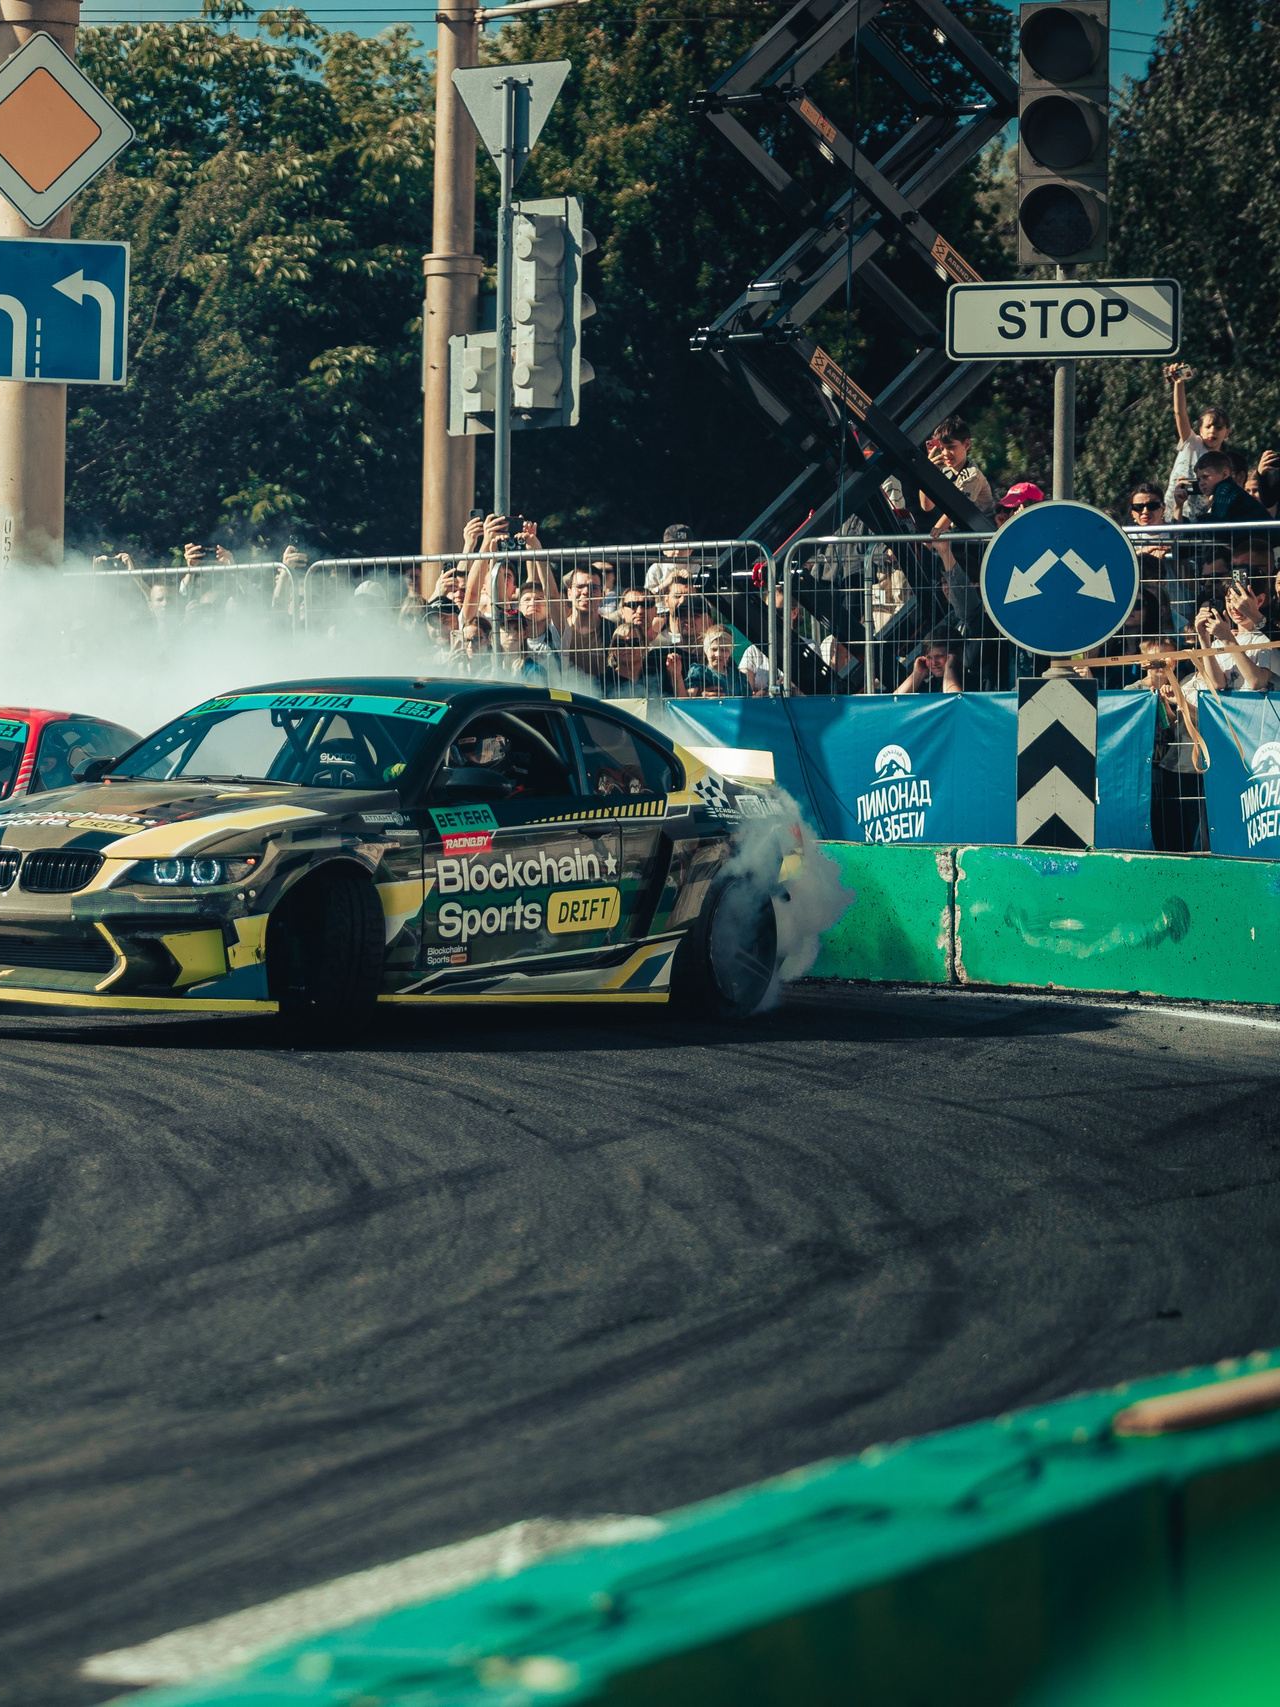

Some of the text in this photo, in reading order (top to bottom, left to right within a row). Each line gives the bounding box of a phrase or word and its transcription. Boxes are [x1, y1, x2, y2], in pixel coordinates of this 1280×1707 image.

[997, 298, 1129, 340] STOP
[269, 695, 355, 709] НАГУЛА
[856, 779, 932, 825] ЛИМОНАД
[80, 820, 136, 831] DRIFT
[864, 811, 925, 843] КАЗБЕГИ
[1246, 809, 1280, 849] КАЗБЕГ
[436, 847, 601, 894] Blockchain
[438, 896, 610, 943] Sports DRIFT
[427, 945, 464, 956] Blockchain
[427, 956, 450, 966] Sports
